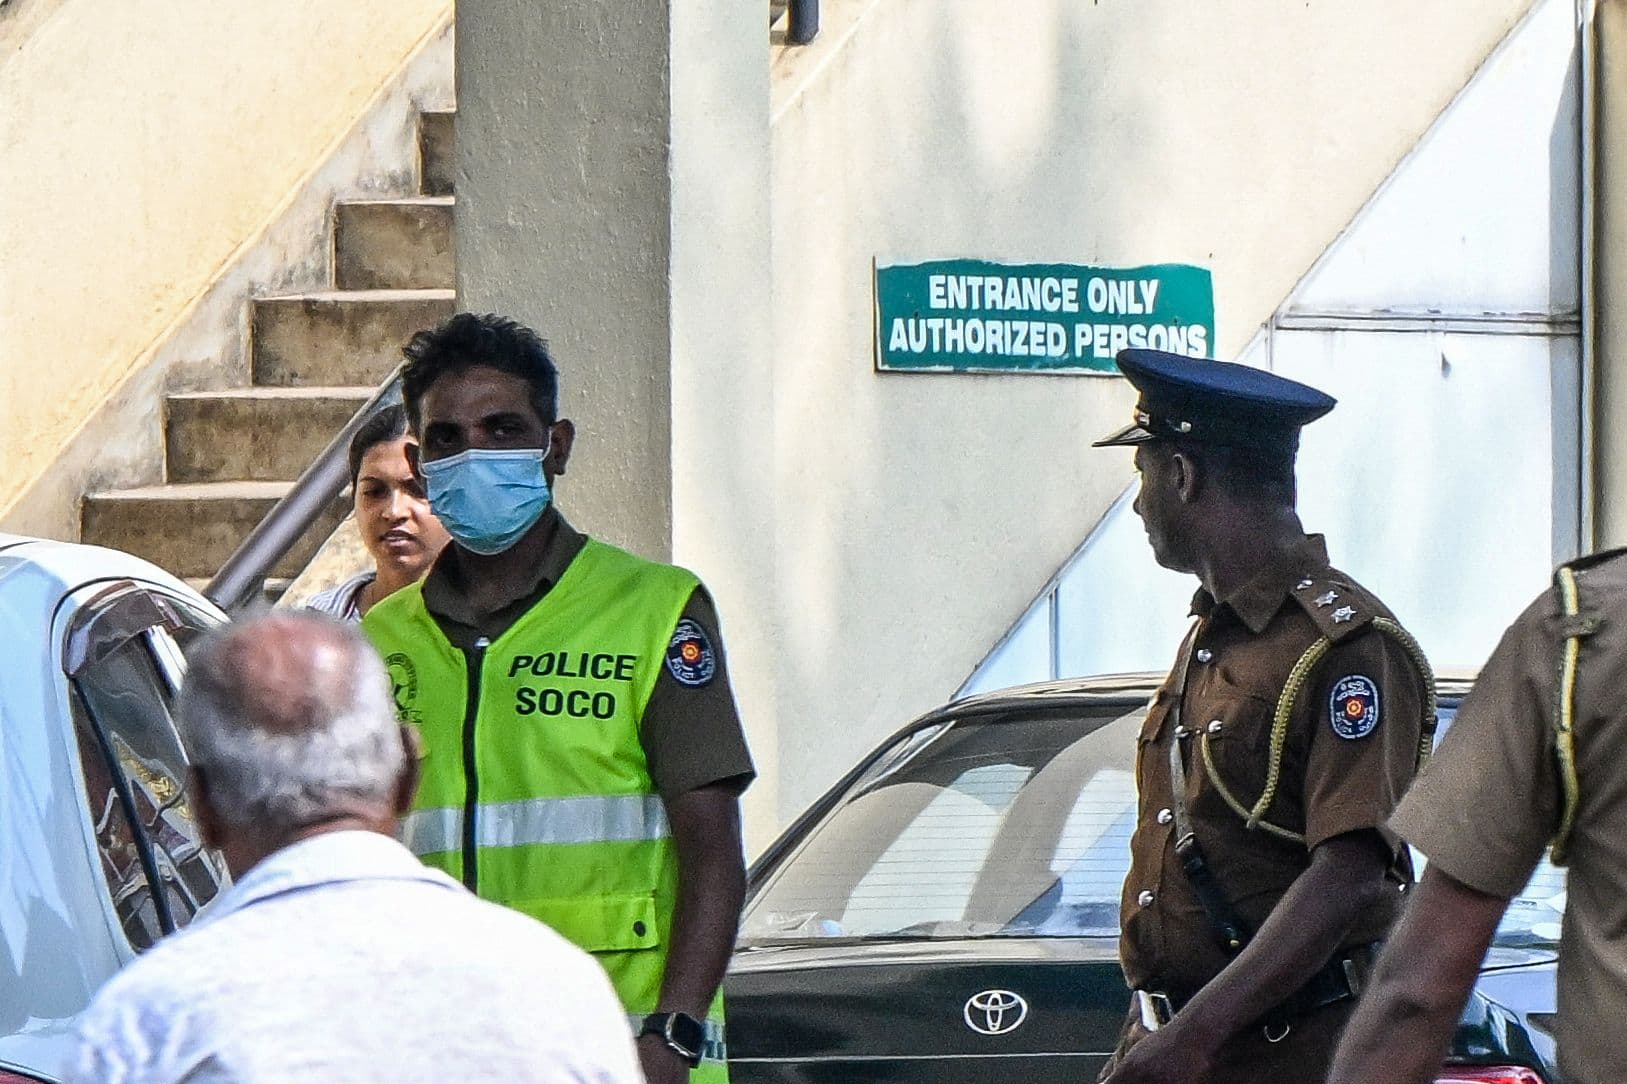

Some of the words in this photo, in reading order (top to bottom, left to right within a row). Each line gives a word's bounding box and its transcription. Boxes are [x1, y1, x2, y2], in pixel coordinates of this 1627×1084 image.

[929, 275, 1079, 313] ENTRANCE
[1087, 277, 1160, 315] ONLY
[889, 318, 1067, 357] AUTHORIZED
[1074, 323, 1208, 359] PERSONS
[508, 652, 638, 682] POLICE
[515, 686, 616, 720] SOCO
